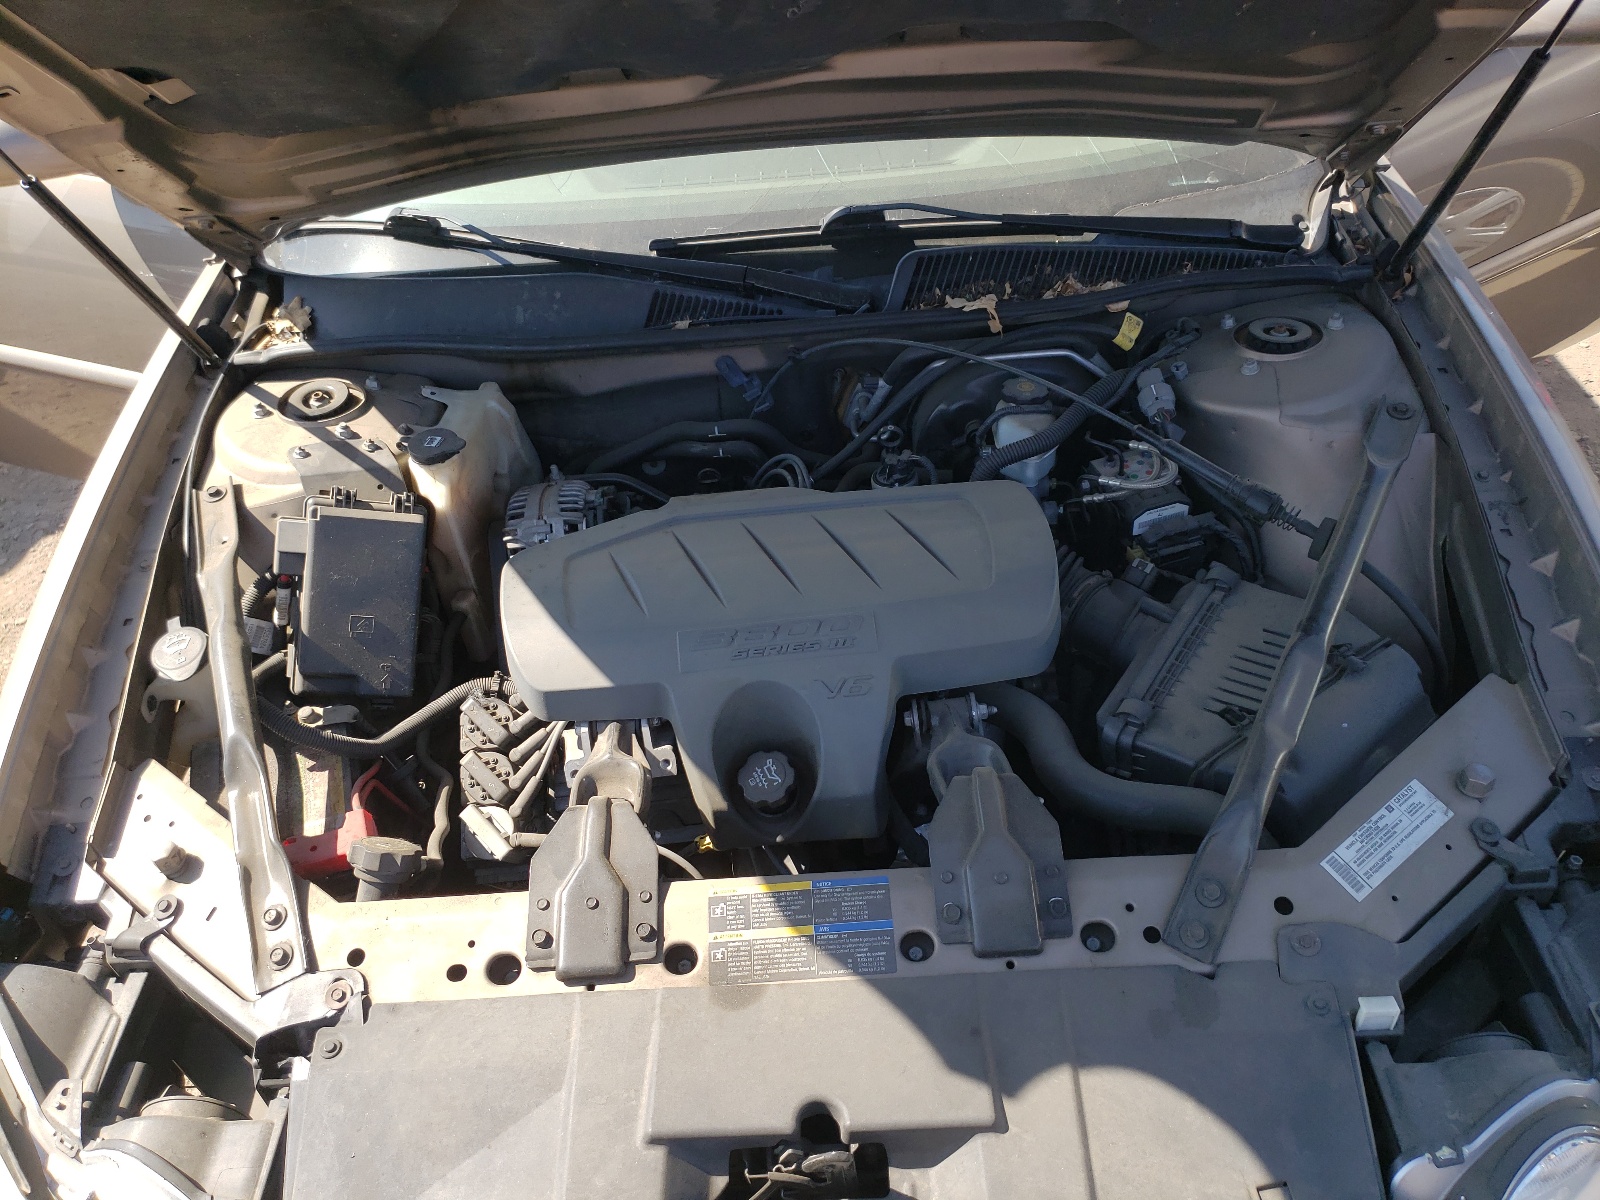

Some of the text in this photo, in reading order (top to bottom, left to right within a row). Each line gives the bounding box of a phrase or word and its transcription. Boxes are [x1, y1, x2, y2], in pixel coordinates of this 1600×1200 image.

[731, 639, 822, 660] SERIES
[814, 674, 874, 700] V6
[1393, 785, 1415, 804] CATALYST
